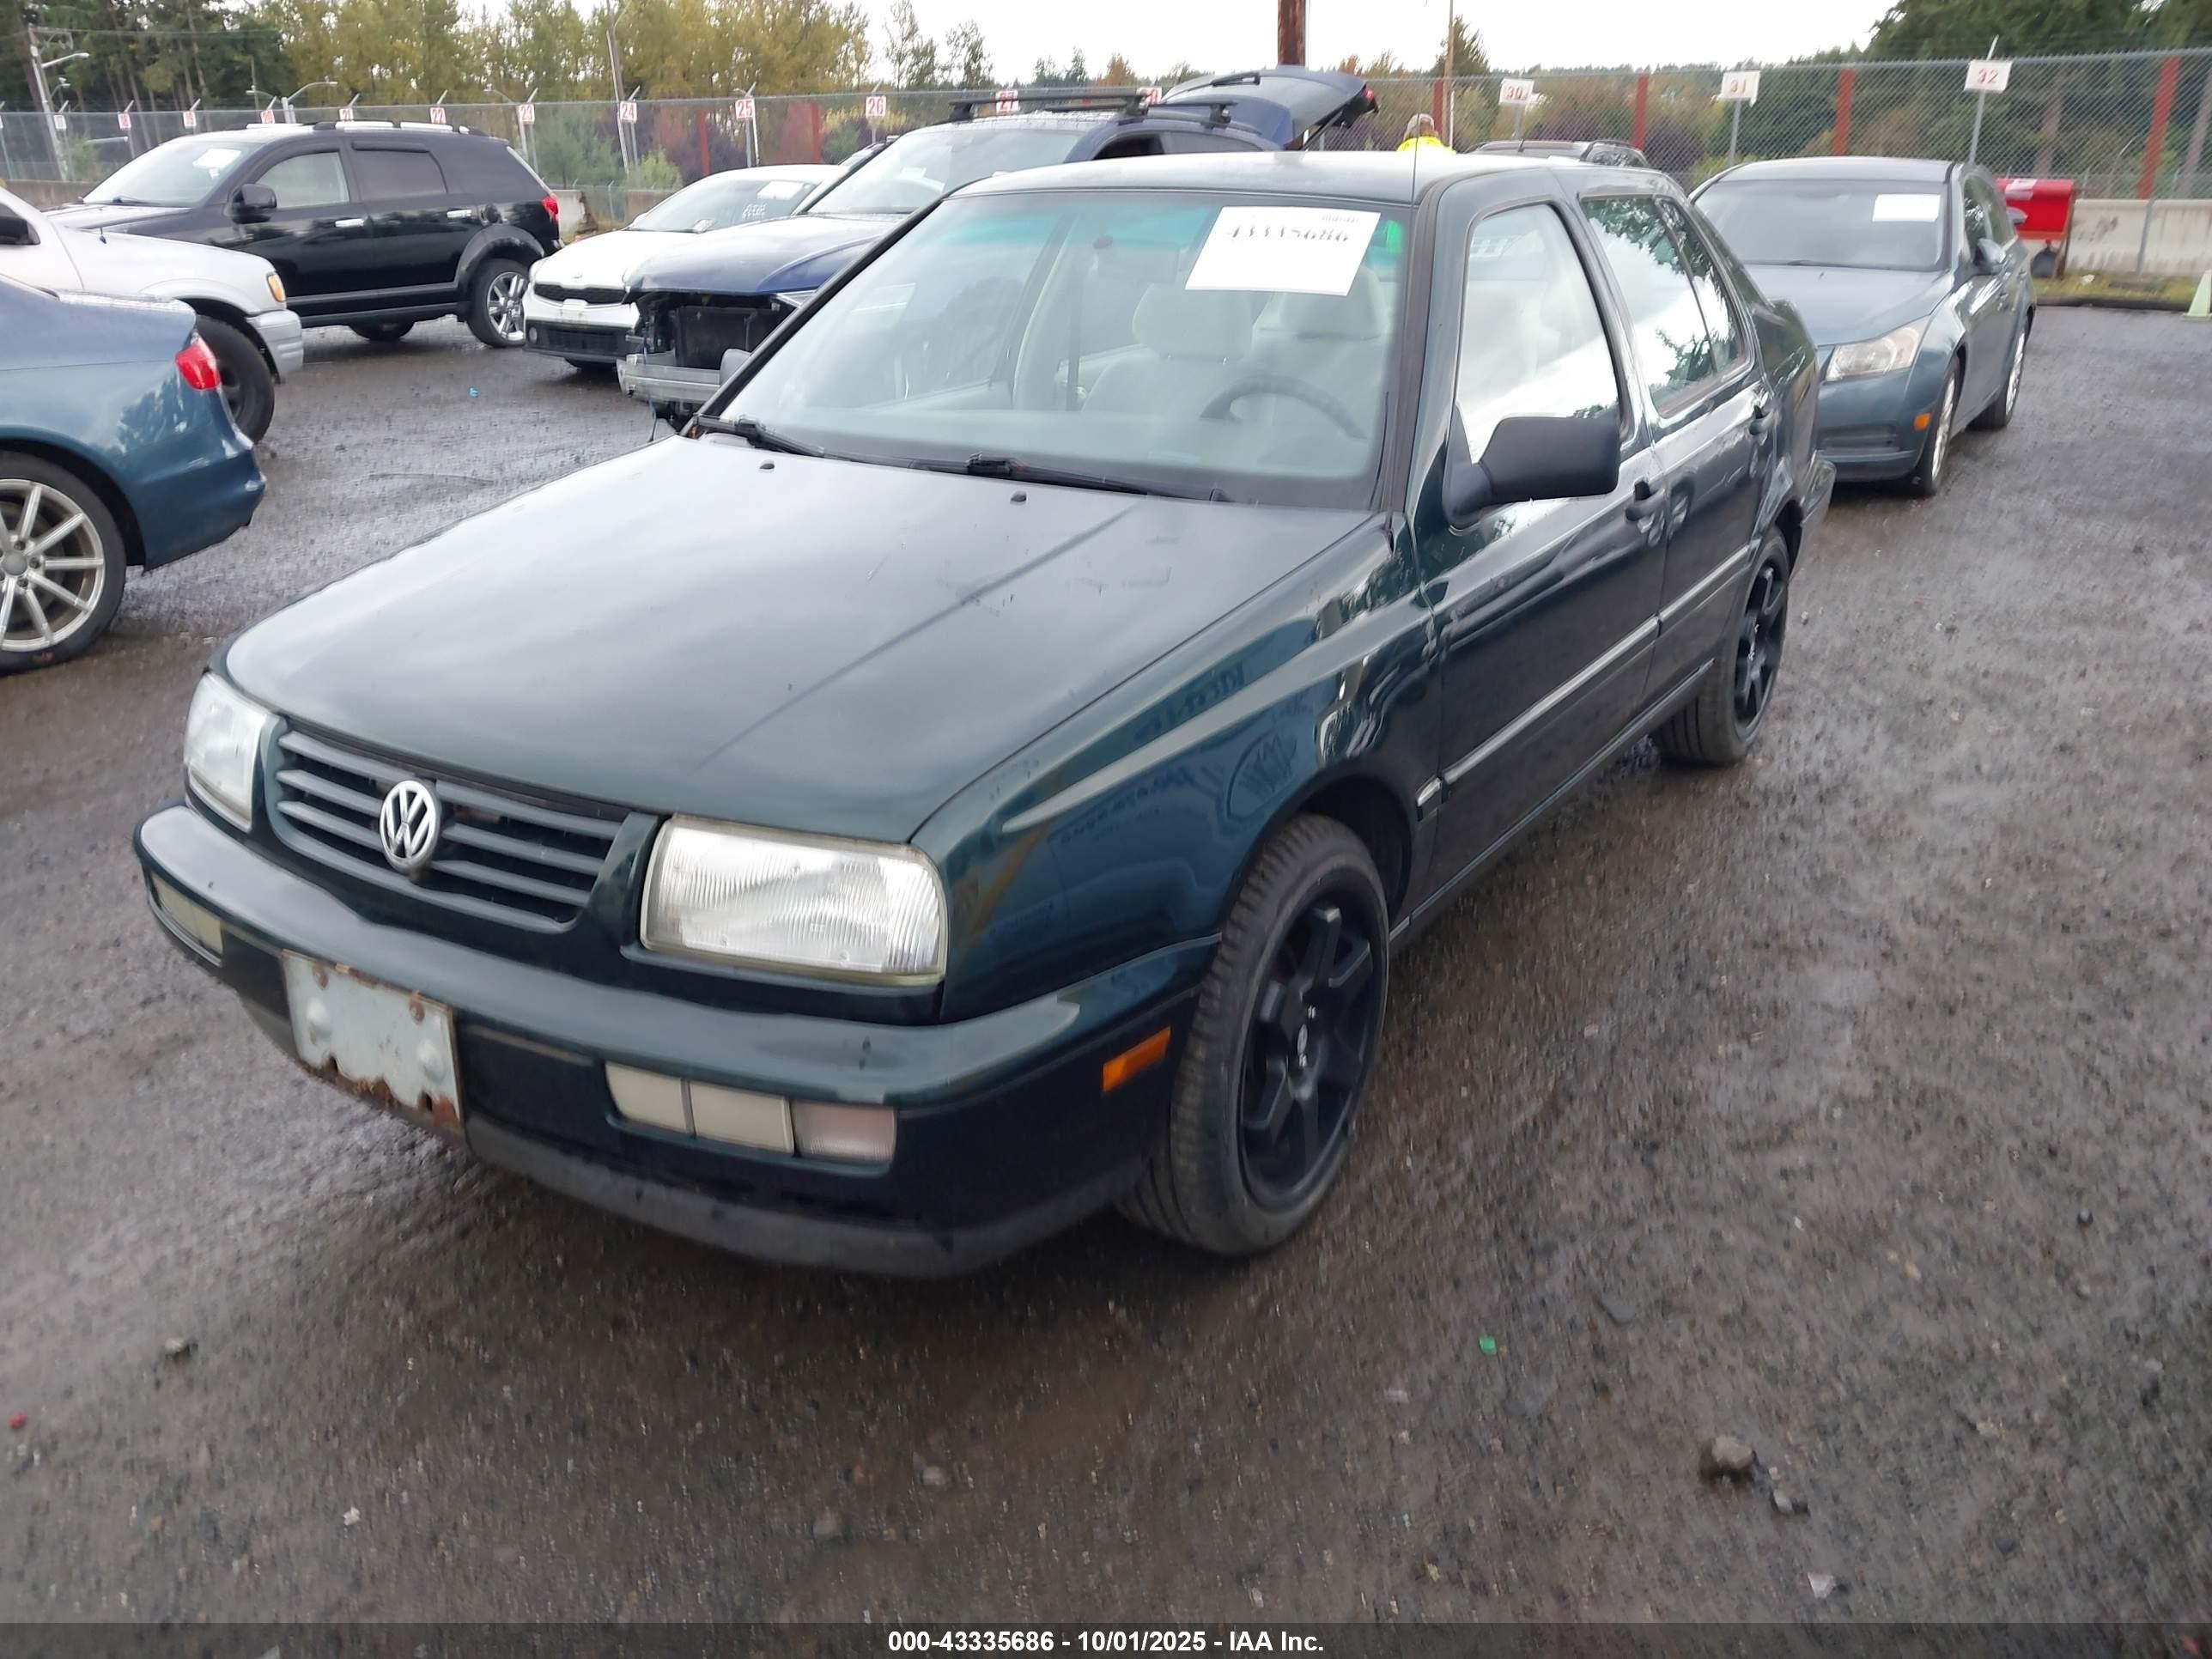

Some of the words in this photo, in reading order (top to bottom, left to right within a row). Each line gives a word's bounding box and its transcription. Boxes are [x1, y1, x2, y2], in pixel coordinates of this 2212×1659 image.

[1978, 68, 1998, 83] 32
[1507, 85, 1522, 100] 30
[1730, 80, 1747, 93] 31
[622, 103, 635, 118] 24
[738, 99, 752, 117] 25
[868, 97, 884, 114] 26
[381, 781, 437, 858] VW
